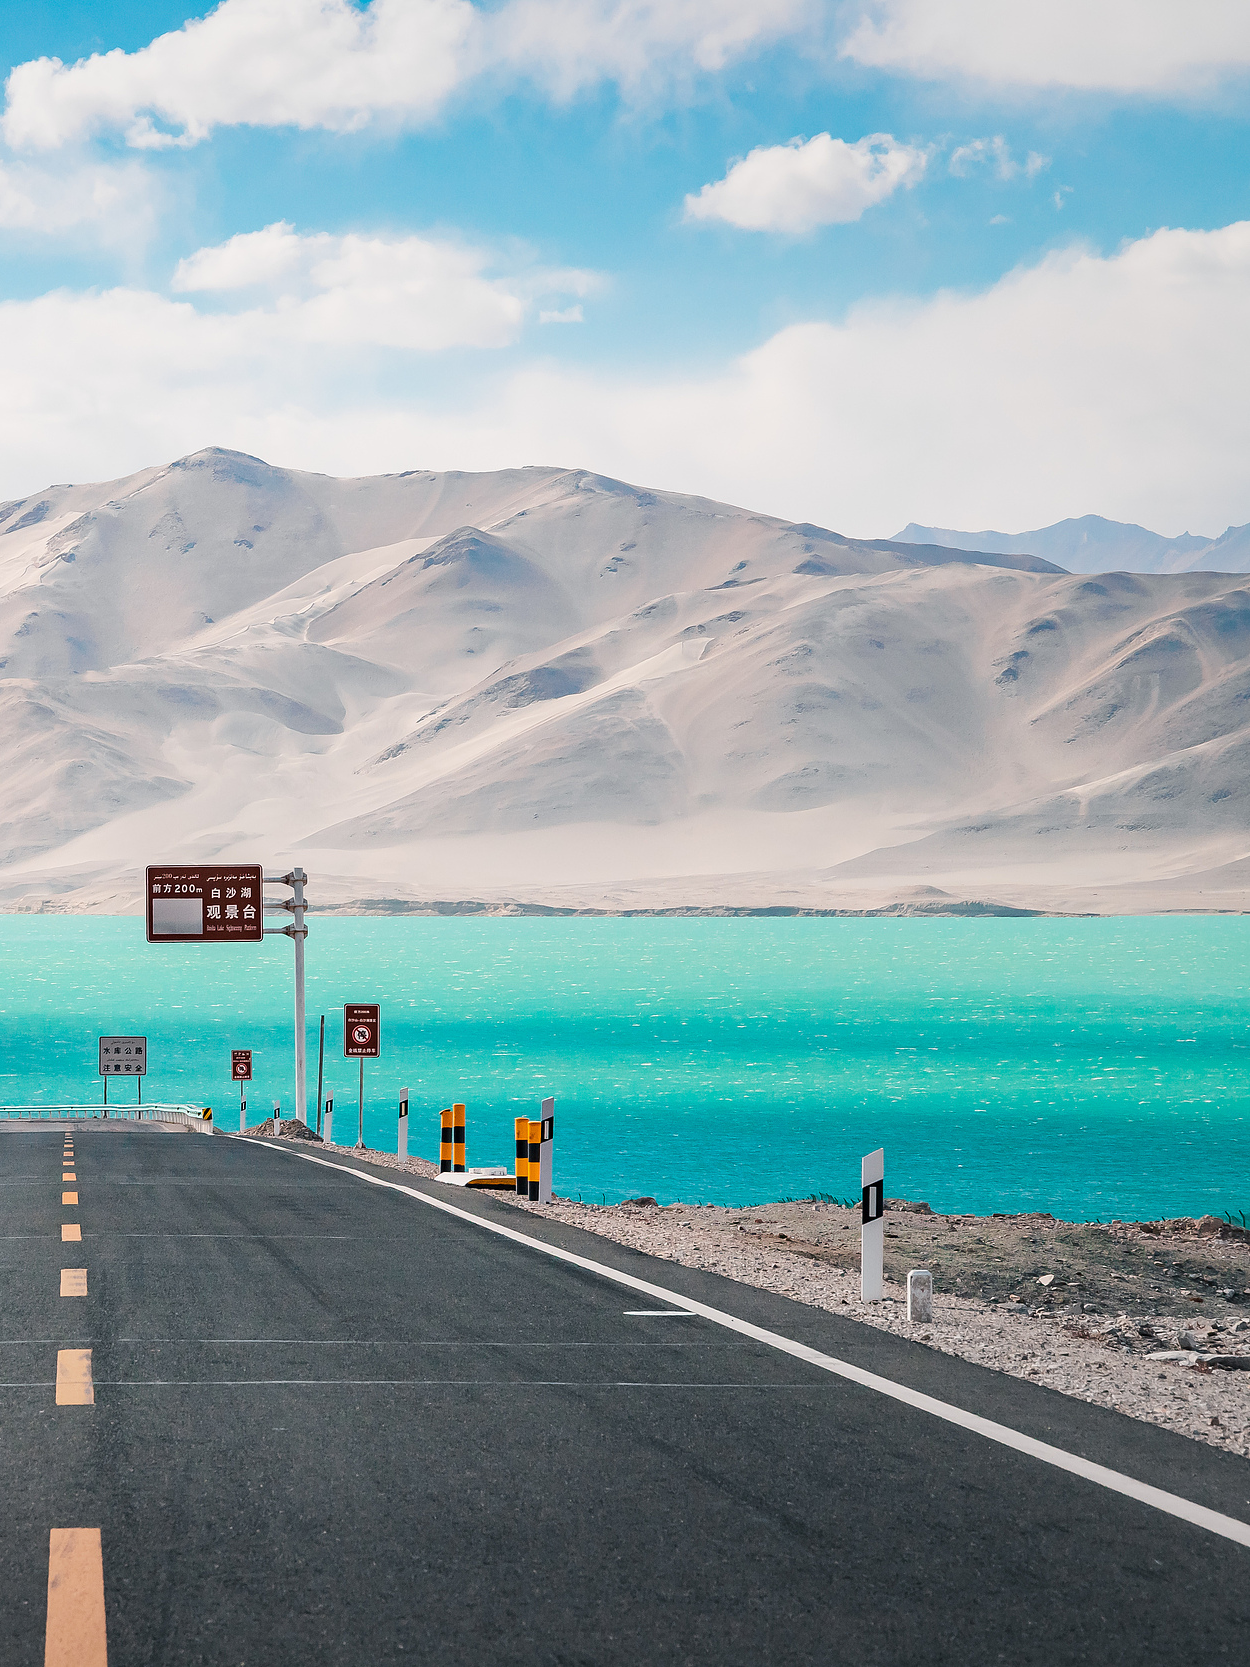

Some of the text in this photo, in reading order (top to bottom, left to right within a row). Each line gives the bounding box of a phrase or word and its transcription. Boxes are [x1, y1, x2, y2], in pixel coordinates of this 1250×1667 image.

[212, 887, 252, 898] 白沙湖
[206, 904, 256, 919] 观景台
[103, 1046, 142, 1054] 水库公路
